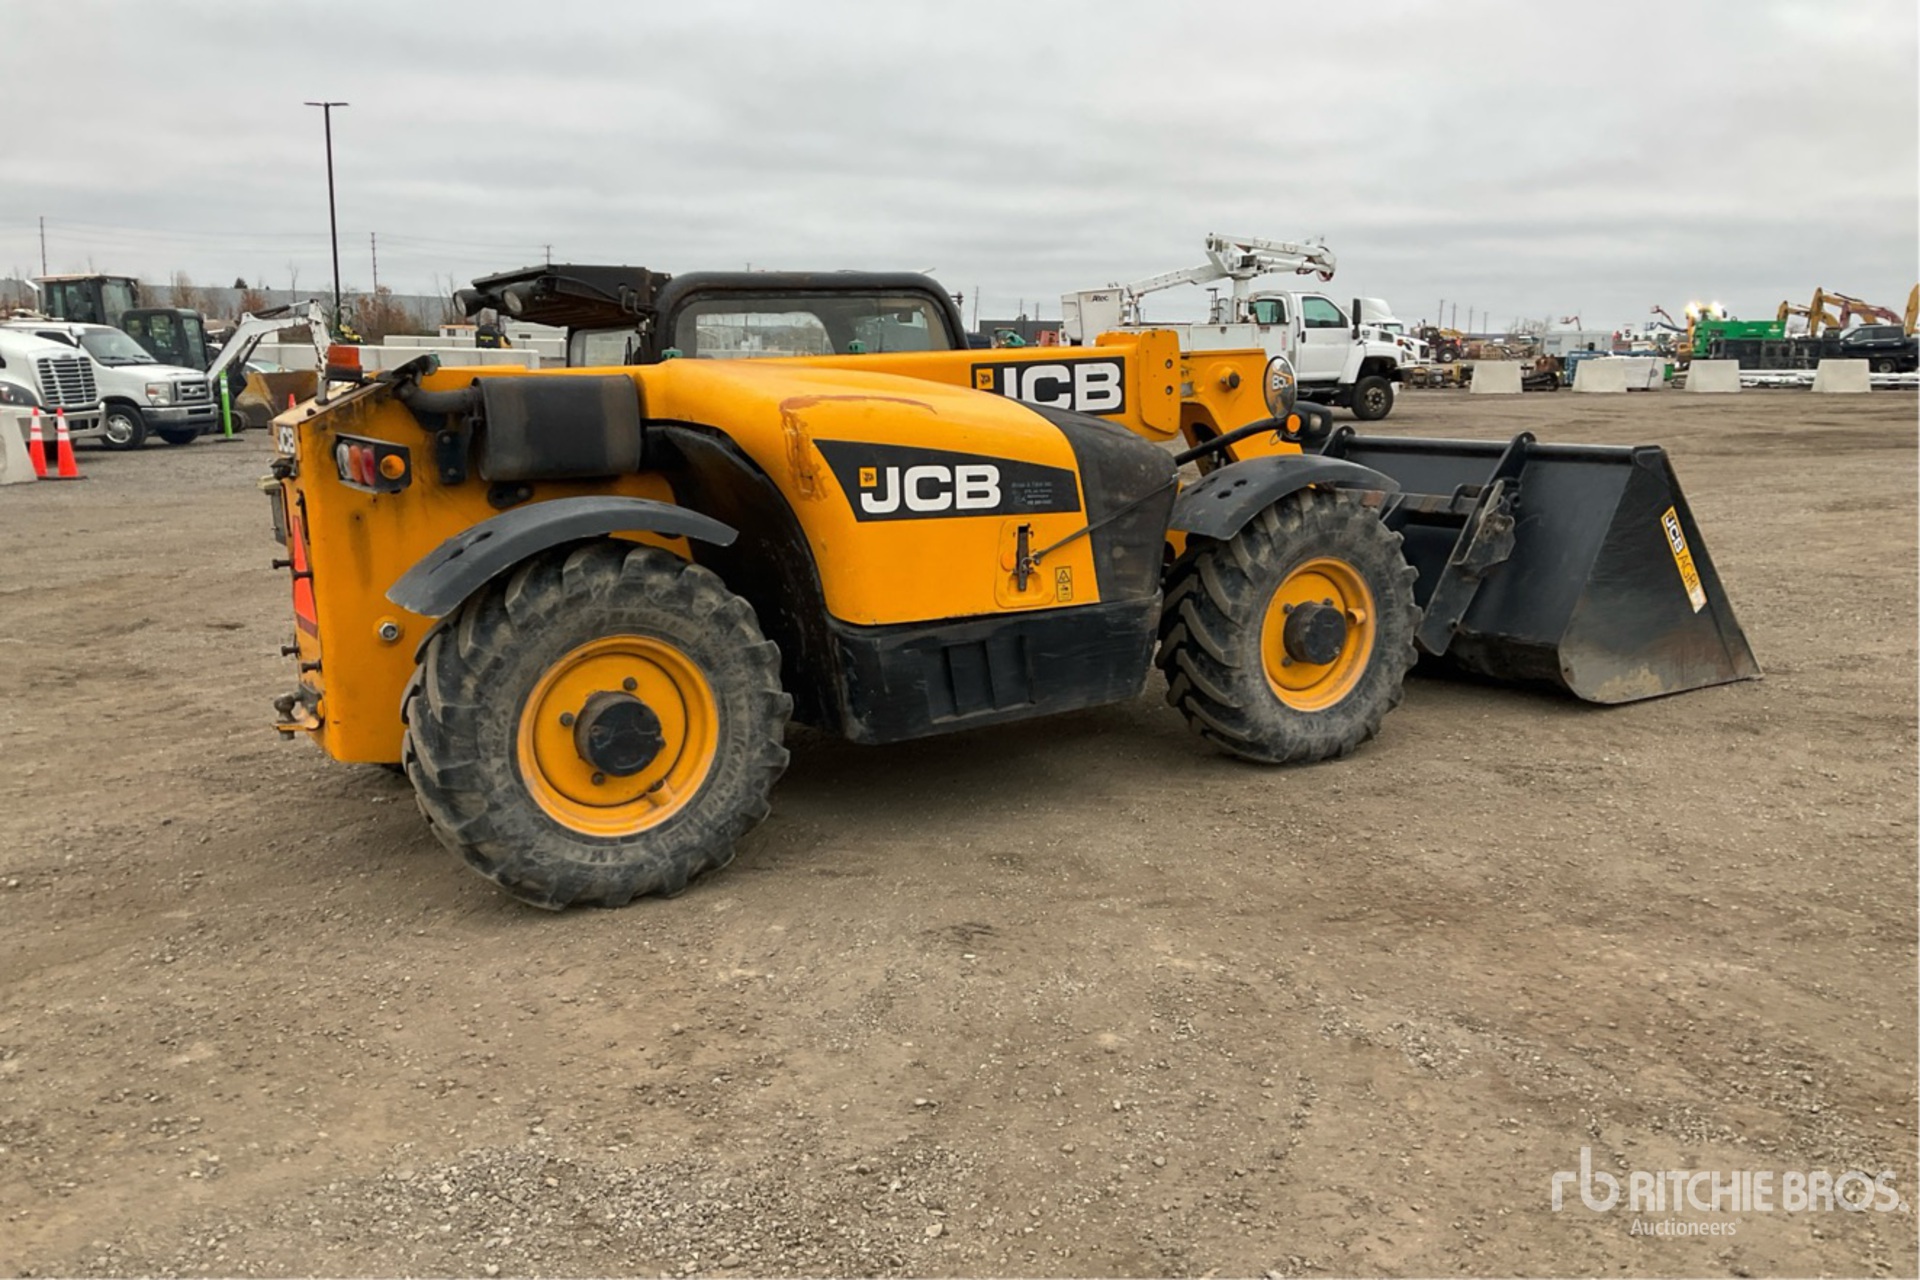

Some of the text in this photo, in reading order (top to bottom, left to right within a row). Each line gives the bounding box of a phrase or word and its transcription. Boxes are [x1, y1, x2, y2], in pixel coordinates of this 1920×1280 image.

[1625, 329, 1631, 338] 5
[860, 464, 1001, 513] JCB
[1665, 516, 1685, 553] JCB
